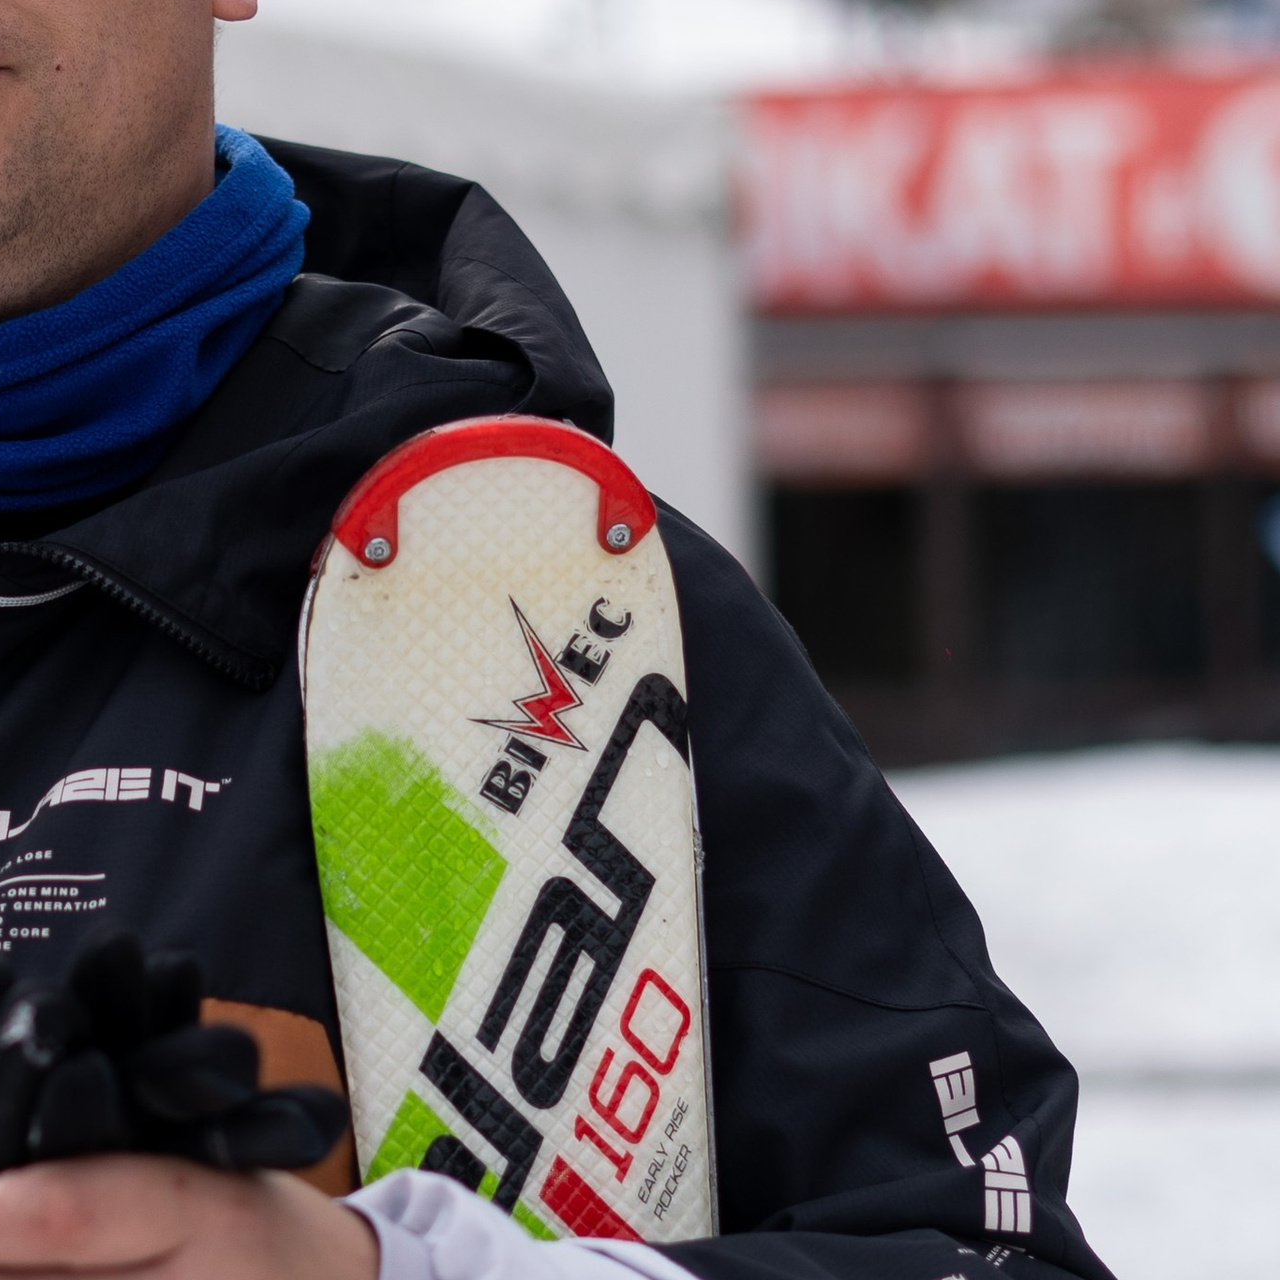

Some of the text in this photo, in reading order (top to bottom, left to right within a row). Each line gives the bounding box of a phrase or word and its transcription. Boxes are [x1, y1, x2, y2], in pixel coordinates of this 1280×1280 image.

[17, 850, 52, 864] LOSE
[7, 887, 37, 898] ONE
[40, 887, 79, 897] MIND
[13, 897, 107, 912] GENERATION
[9, 927, 51, 938] CORE
[417, 672, 690, 1218] lan
[575, 967, 691, 1184] 160
[637, 1096, 690, 1205] EARLY RISE
[653, 1143, 693, 1222] ROCKER
